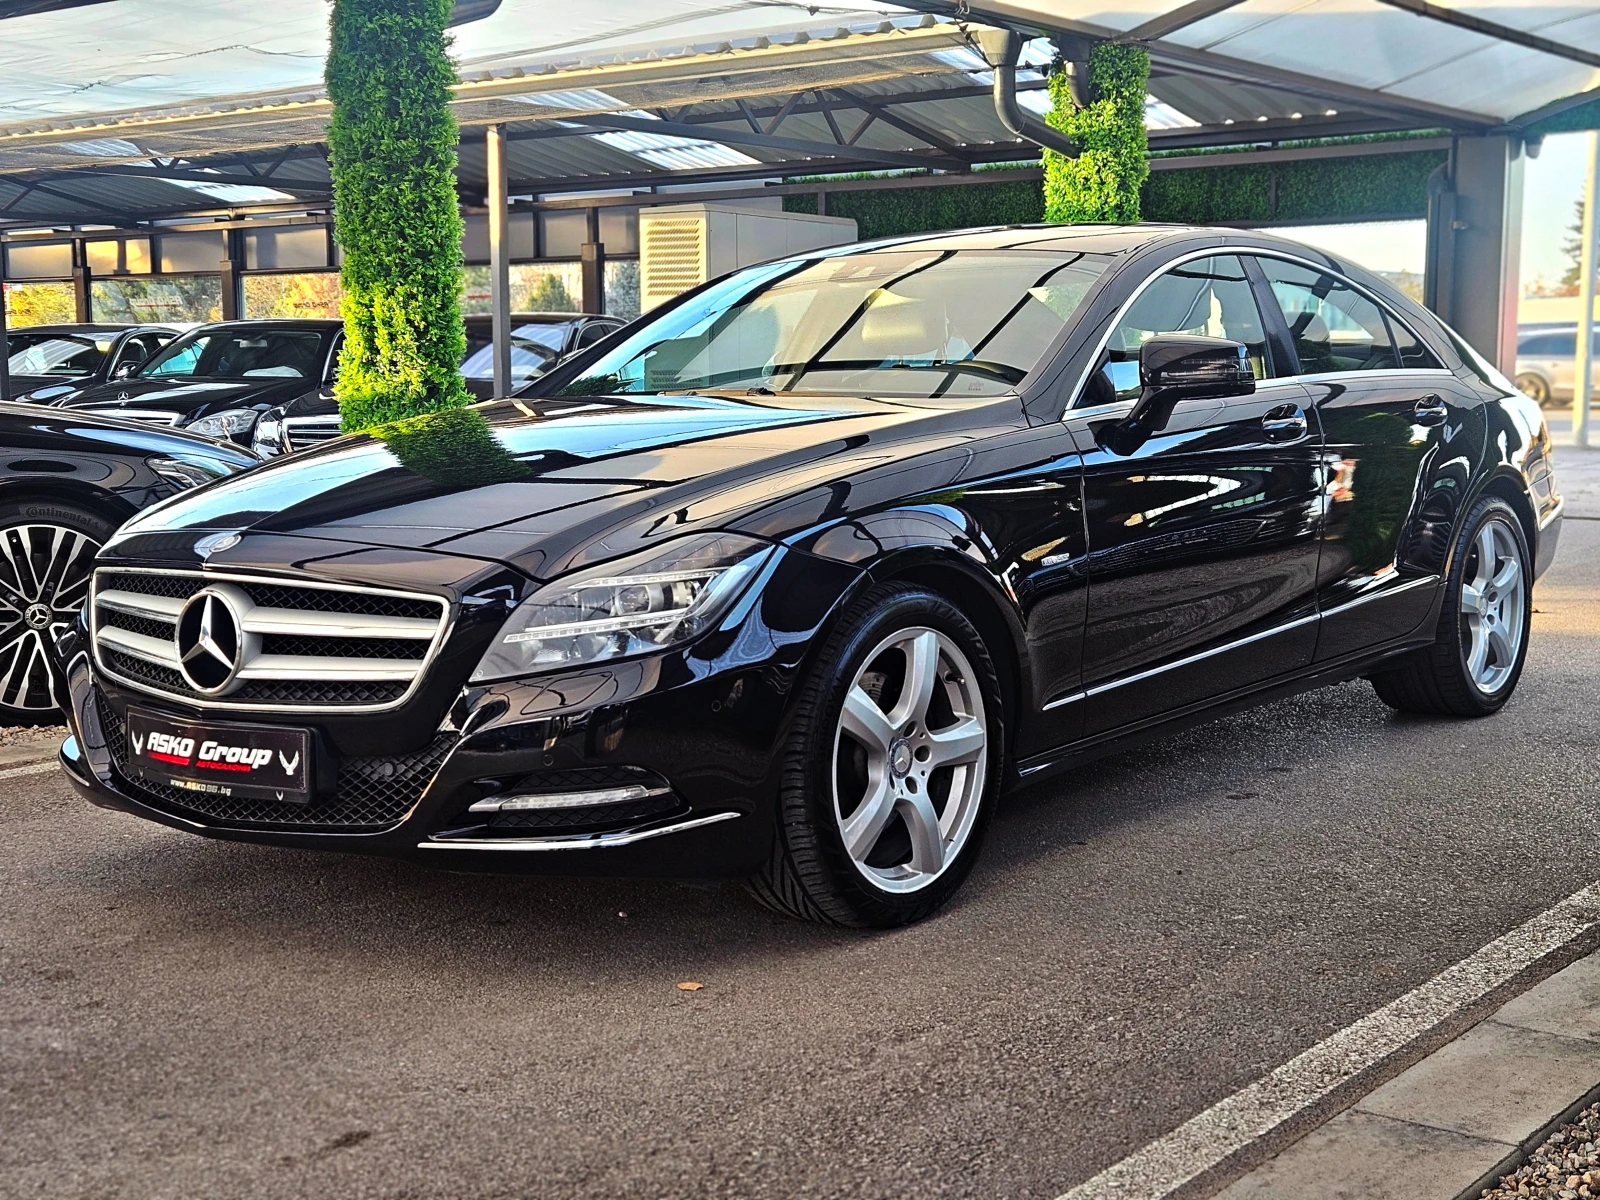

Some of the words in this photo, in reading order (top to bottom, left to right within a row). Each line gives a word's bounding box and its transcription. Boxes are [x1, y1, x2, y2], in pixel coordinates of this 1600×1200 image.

[26, 506, 93, 525] Continental
[147, 732, 195, 757] ASKO
[198, 741, 272, 769] Group
